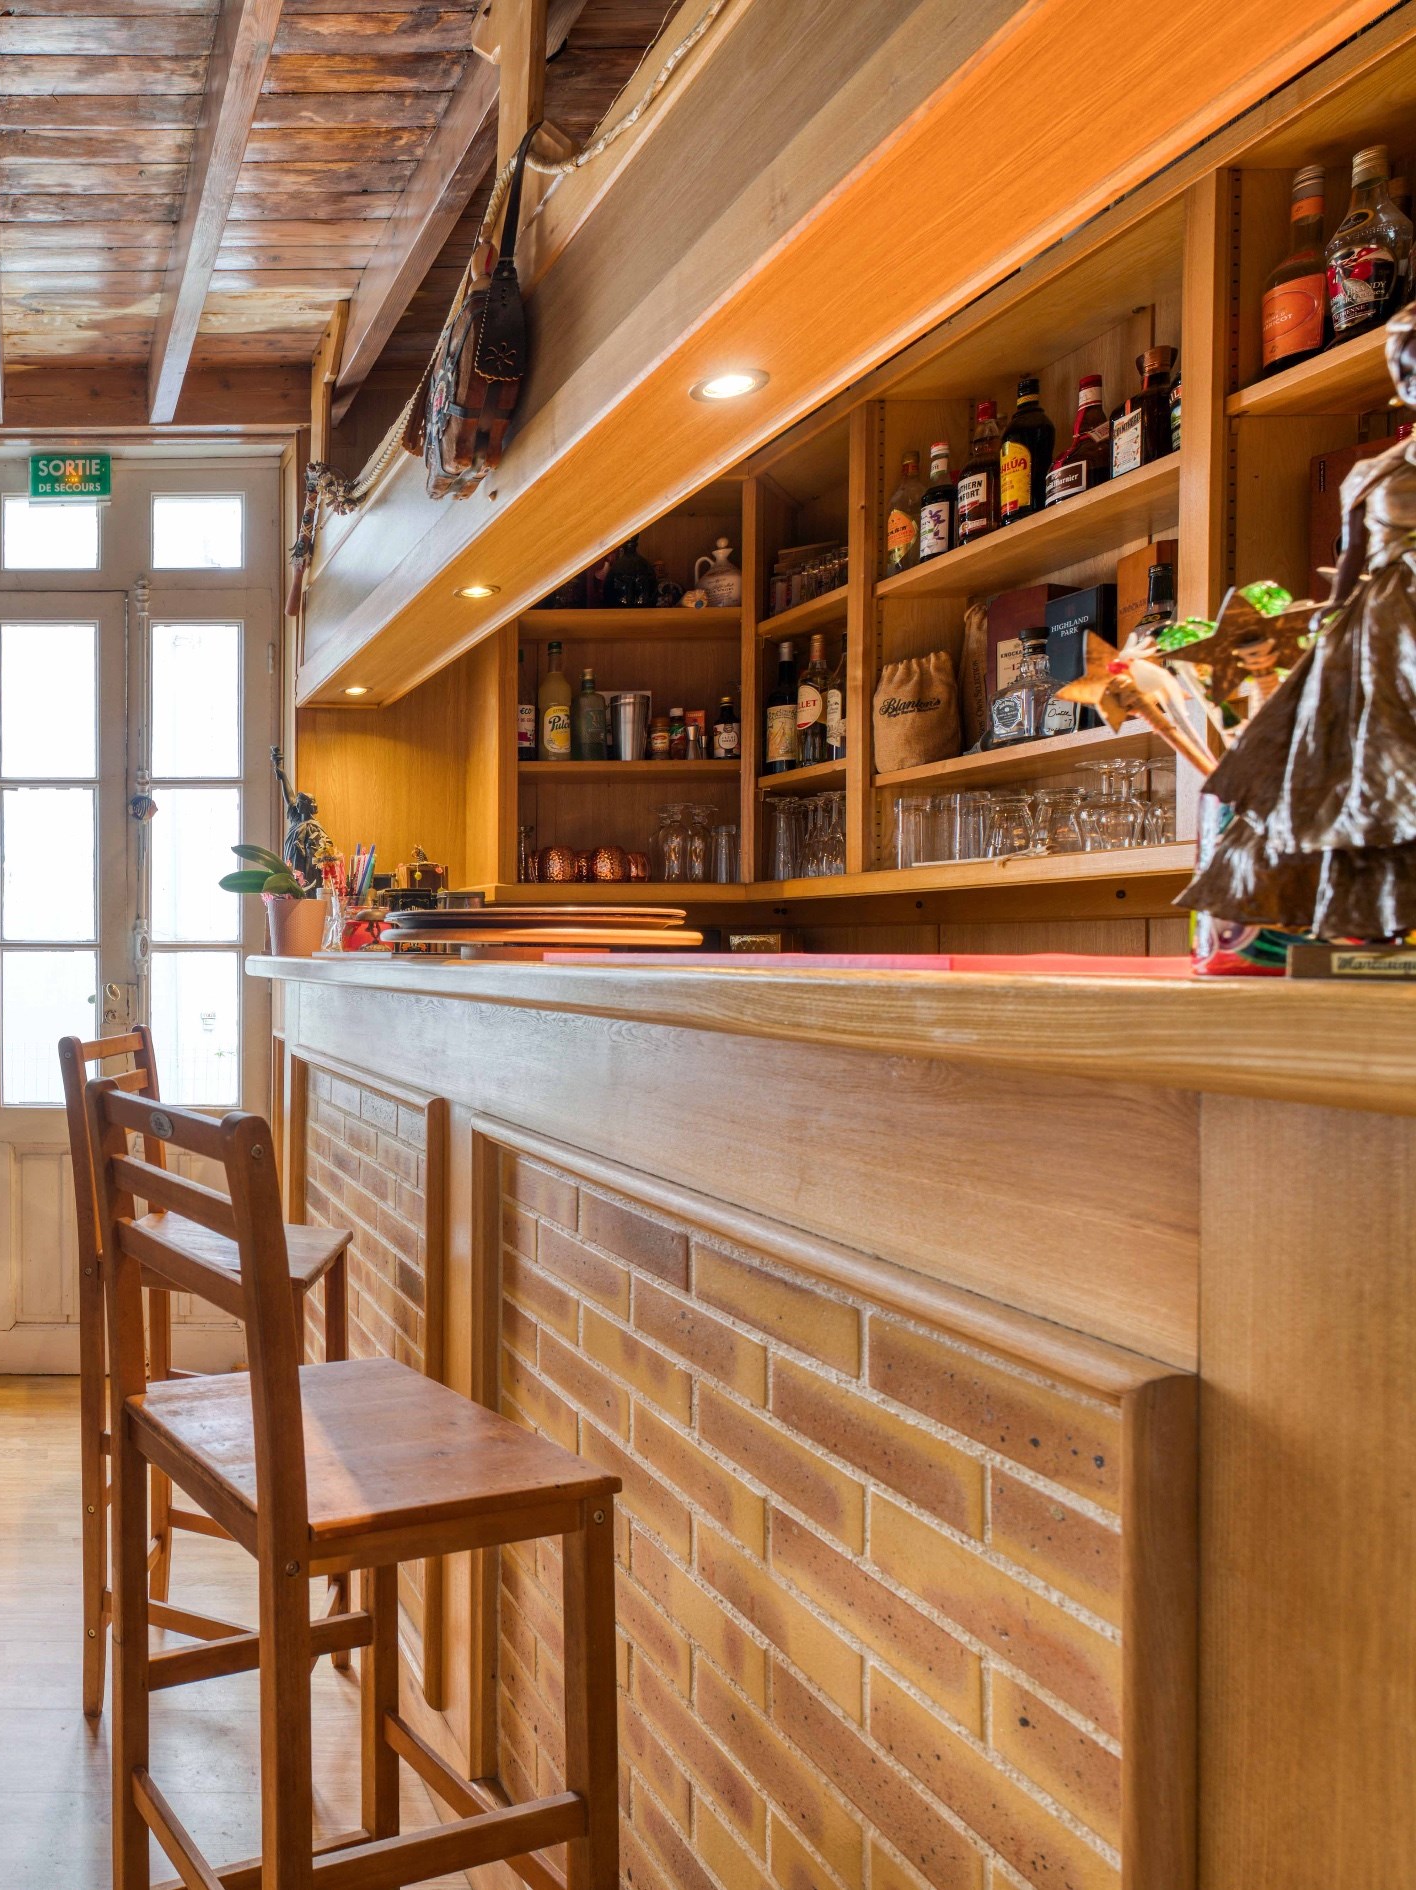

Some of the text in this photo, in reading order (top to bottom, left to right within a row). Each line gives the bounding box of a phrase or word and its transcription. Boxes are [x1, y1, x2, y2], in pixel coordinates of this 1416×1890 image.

[38, 459, 101, 477] SORTIE
[38, 482, 101, 493] DE SECOURS
[1051, 615, 1089, 633] HIGHLAND
[1060, 626, 1079, 638] PARK
[1000, 648, 1022, 659] KNOCKA
[798, 700, 817, 709] LLET
[879, 697, 941, 715] Blanton's
